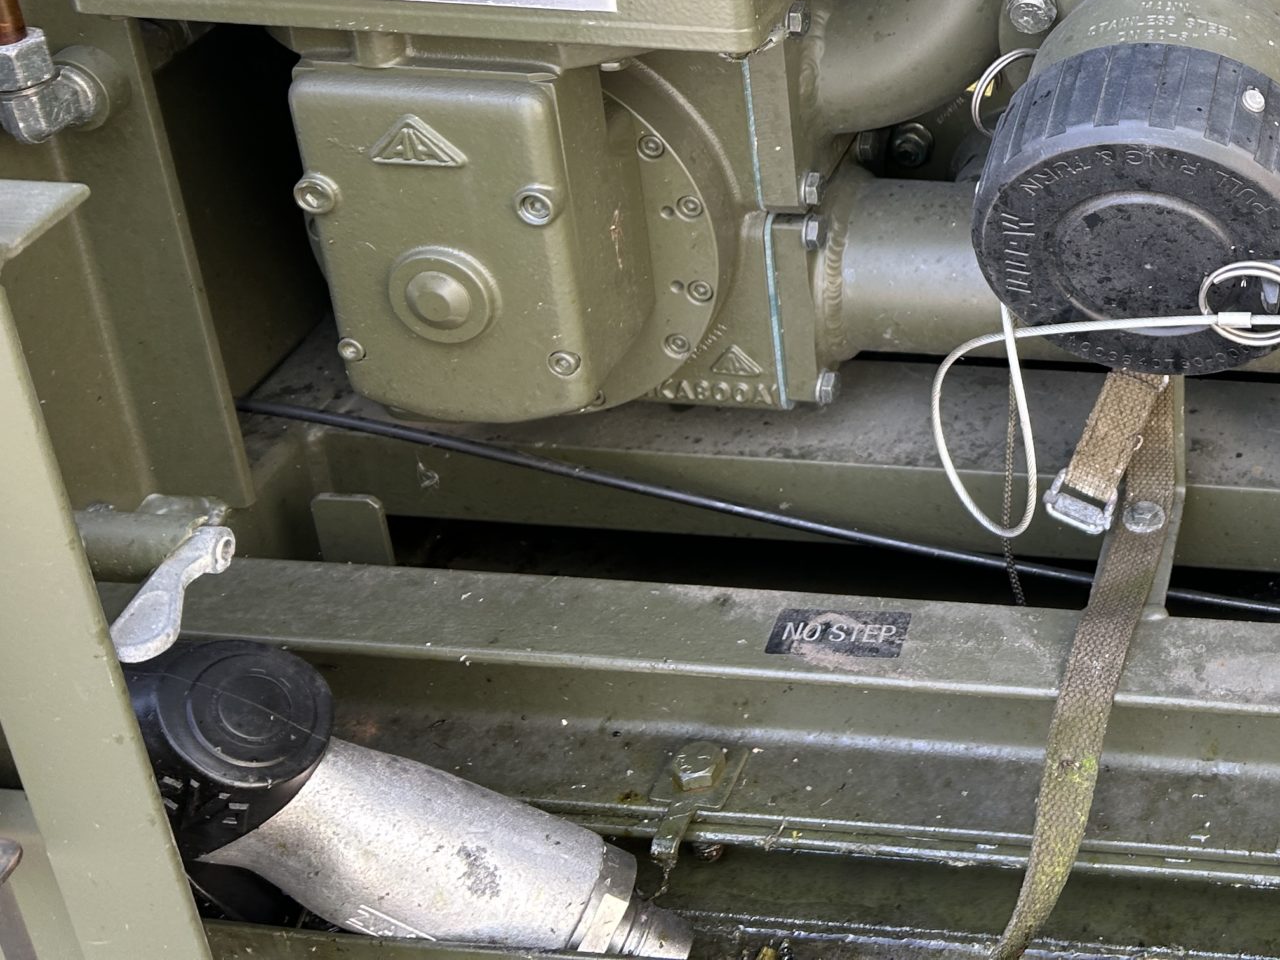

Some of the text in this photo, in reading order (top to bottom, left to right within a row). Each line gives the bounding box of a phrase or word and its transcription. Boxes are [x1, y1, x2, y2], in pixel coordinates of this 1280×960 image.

[1020, 155, 1092, 197] TURN
[1125, 148, 1201, 176] RING
[1214, 170, 1276, 215] PULL
[781, 621, 897, 643] NO STEP
